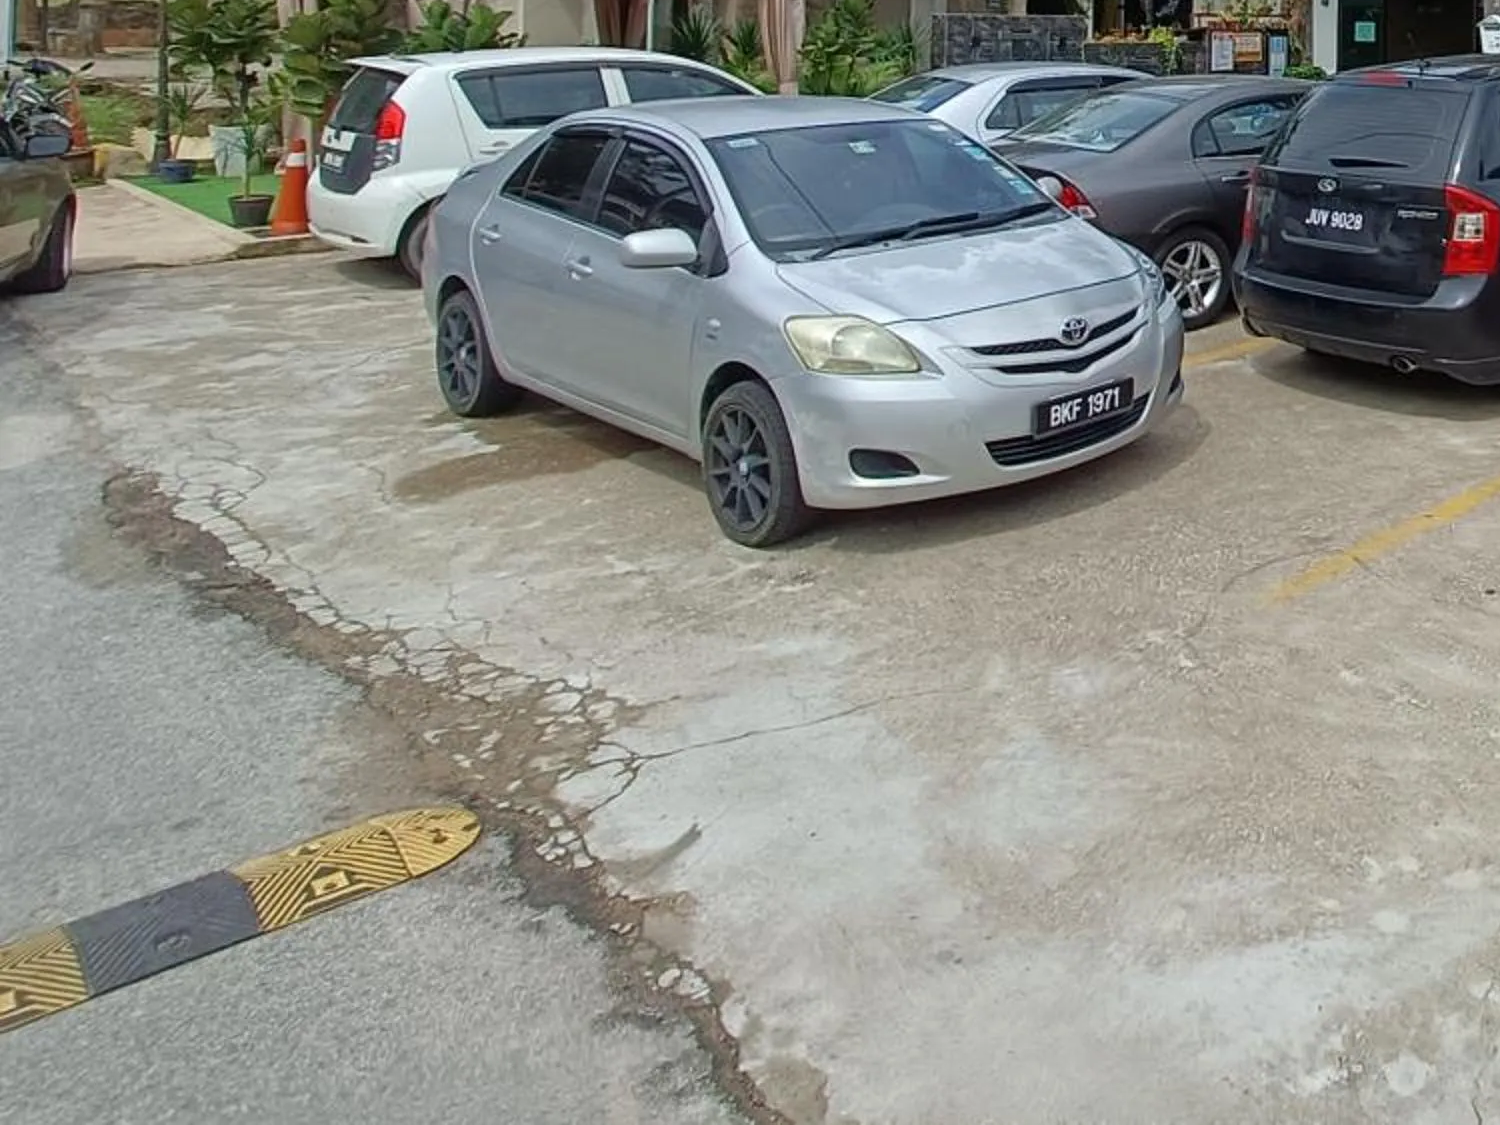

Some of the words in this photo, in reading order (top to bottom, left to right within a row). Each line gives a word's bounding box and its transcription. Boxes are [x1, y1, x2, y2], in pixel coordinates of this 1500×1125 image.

[1304, 207, 1331, 226] JUV
[1050, 398, 1082, 427] BKF
[1087, 386, 1120, 417] 1971
